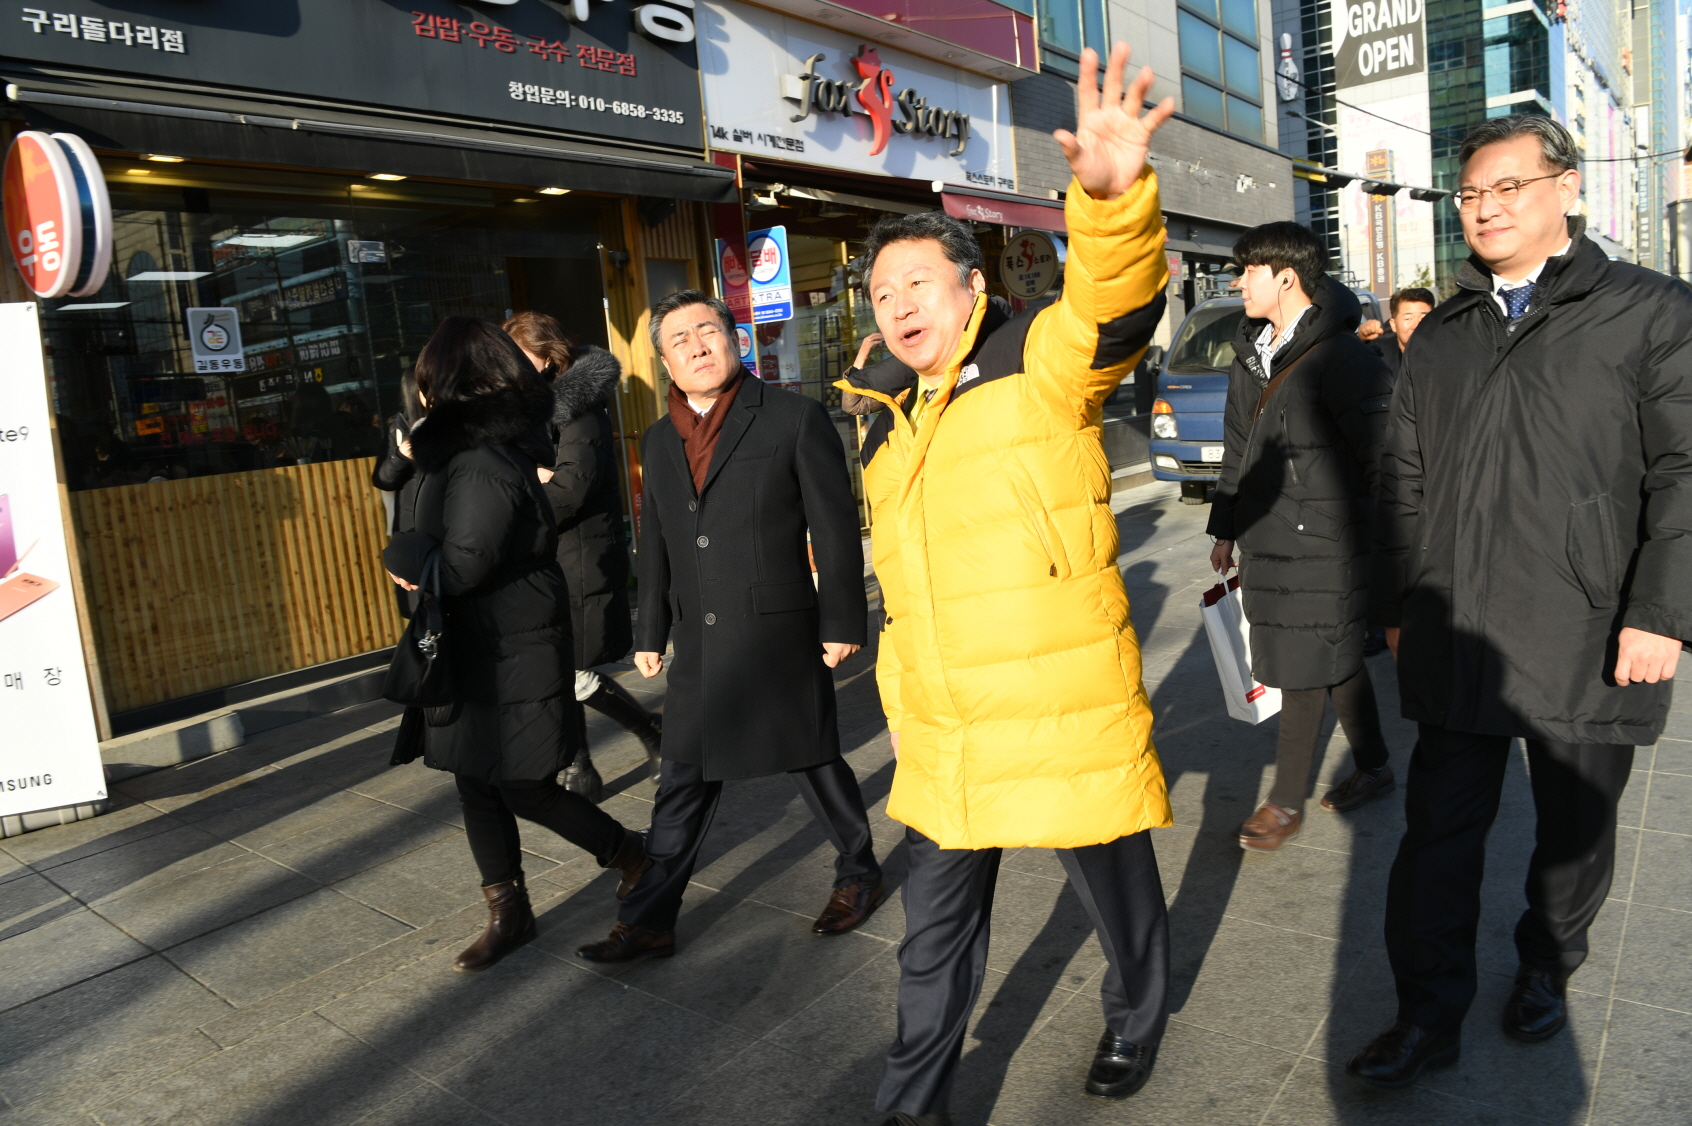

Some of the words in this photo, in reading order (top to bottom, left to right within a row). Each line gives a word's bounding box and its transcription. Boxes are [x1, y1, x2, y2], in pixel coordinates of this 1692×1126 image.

[22, 8, 185, 53] 구리돌다리점
[1349, 0, 1421, 37] GRAND
[576, 44, 637, 76] 전문점
[1358, 33, 1414, 77] OPEN
[578, 95, 684, 125] 010-6858-3335
[789, 53, 866, 123] fox
[895, 88, 972, 156] Story
[733, 128, 753, 144] 실버
[18, 220, 61, 277] 우동
[749, 247, 777, 268] 담배
